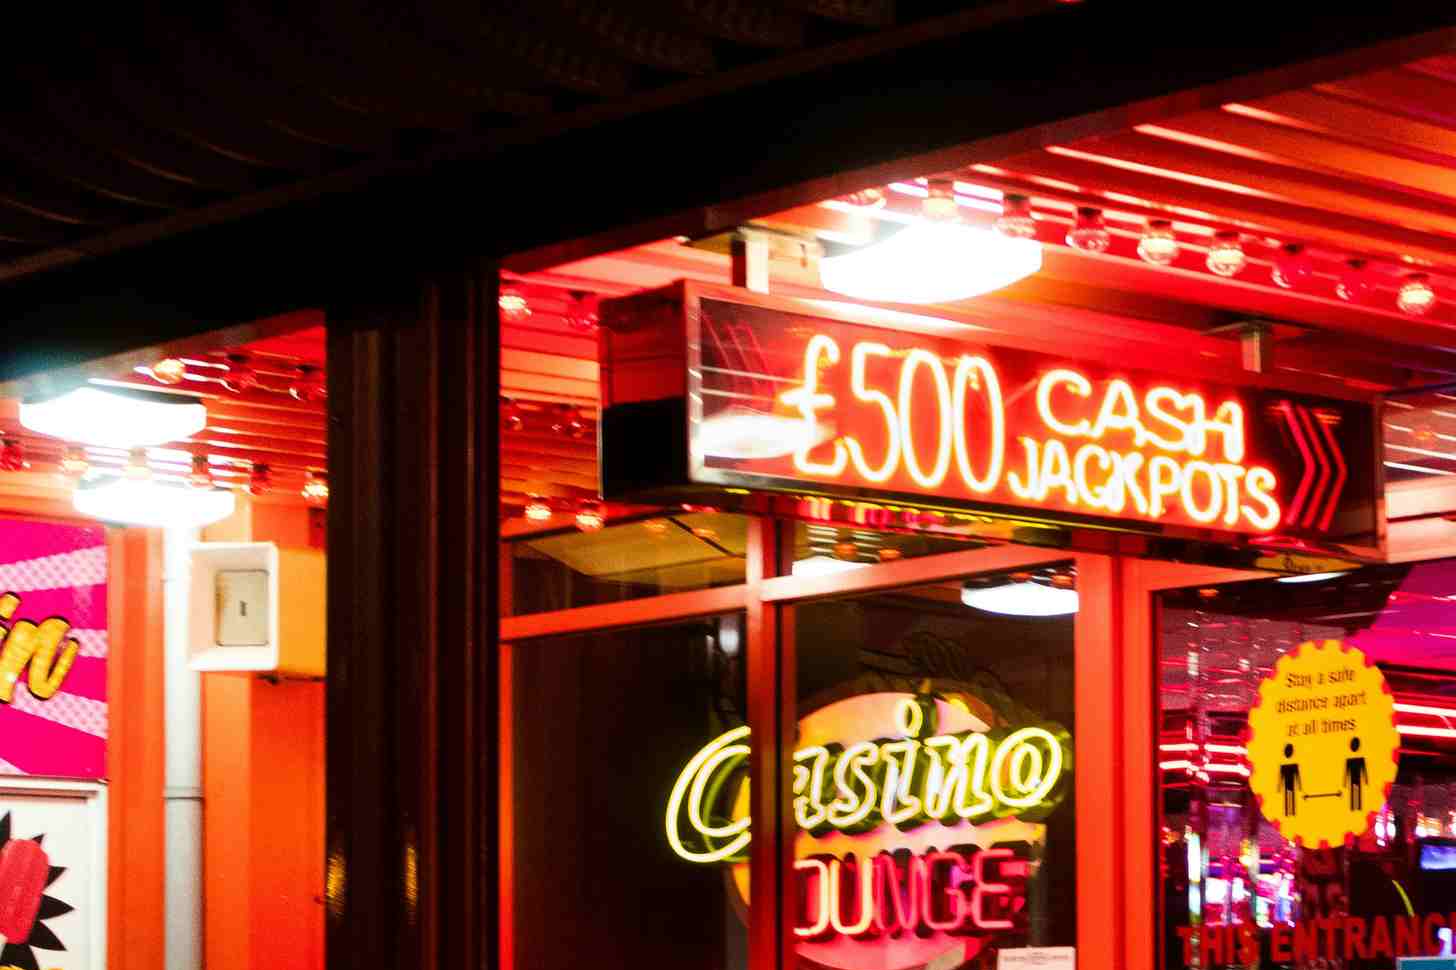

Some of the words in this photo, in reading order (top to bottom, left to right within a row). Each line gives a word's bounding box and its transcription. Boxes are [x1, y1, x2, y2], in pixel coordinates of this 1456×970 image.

[779, 334, 1006, 494] £500
[1038, 369, 1245, 462] CASH
[1008, 434, 1281, 530] JACKPOTS
[1285, 672, 1312, 689] Stay
[1328, 667, 1355, 684] safe
[1276, 696, 1329, 714] distance
[1334, 690, 1367, 711] apart
[1320, 718, 1357, 734] times
[1177, 925, 1260, 965] THIS
